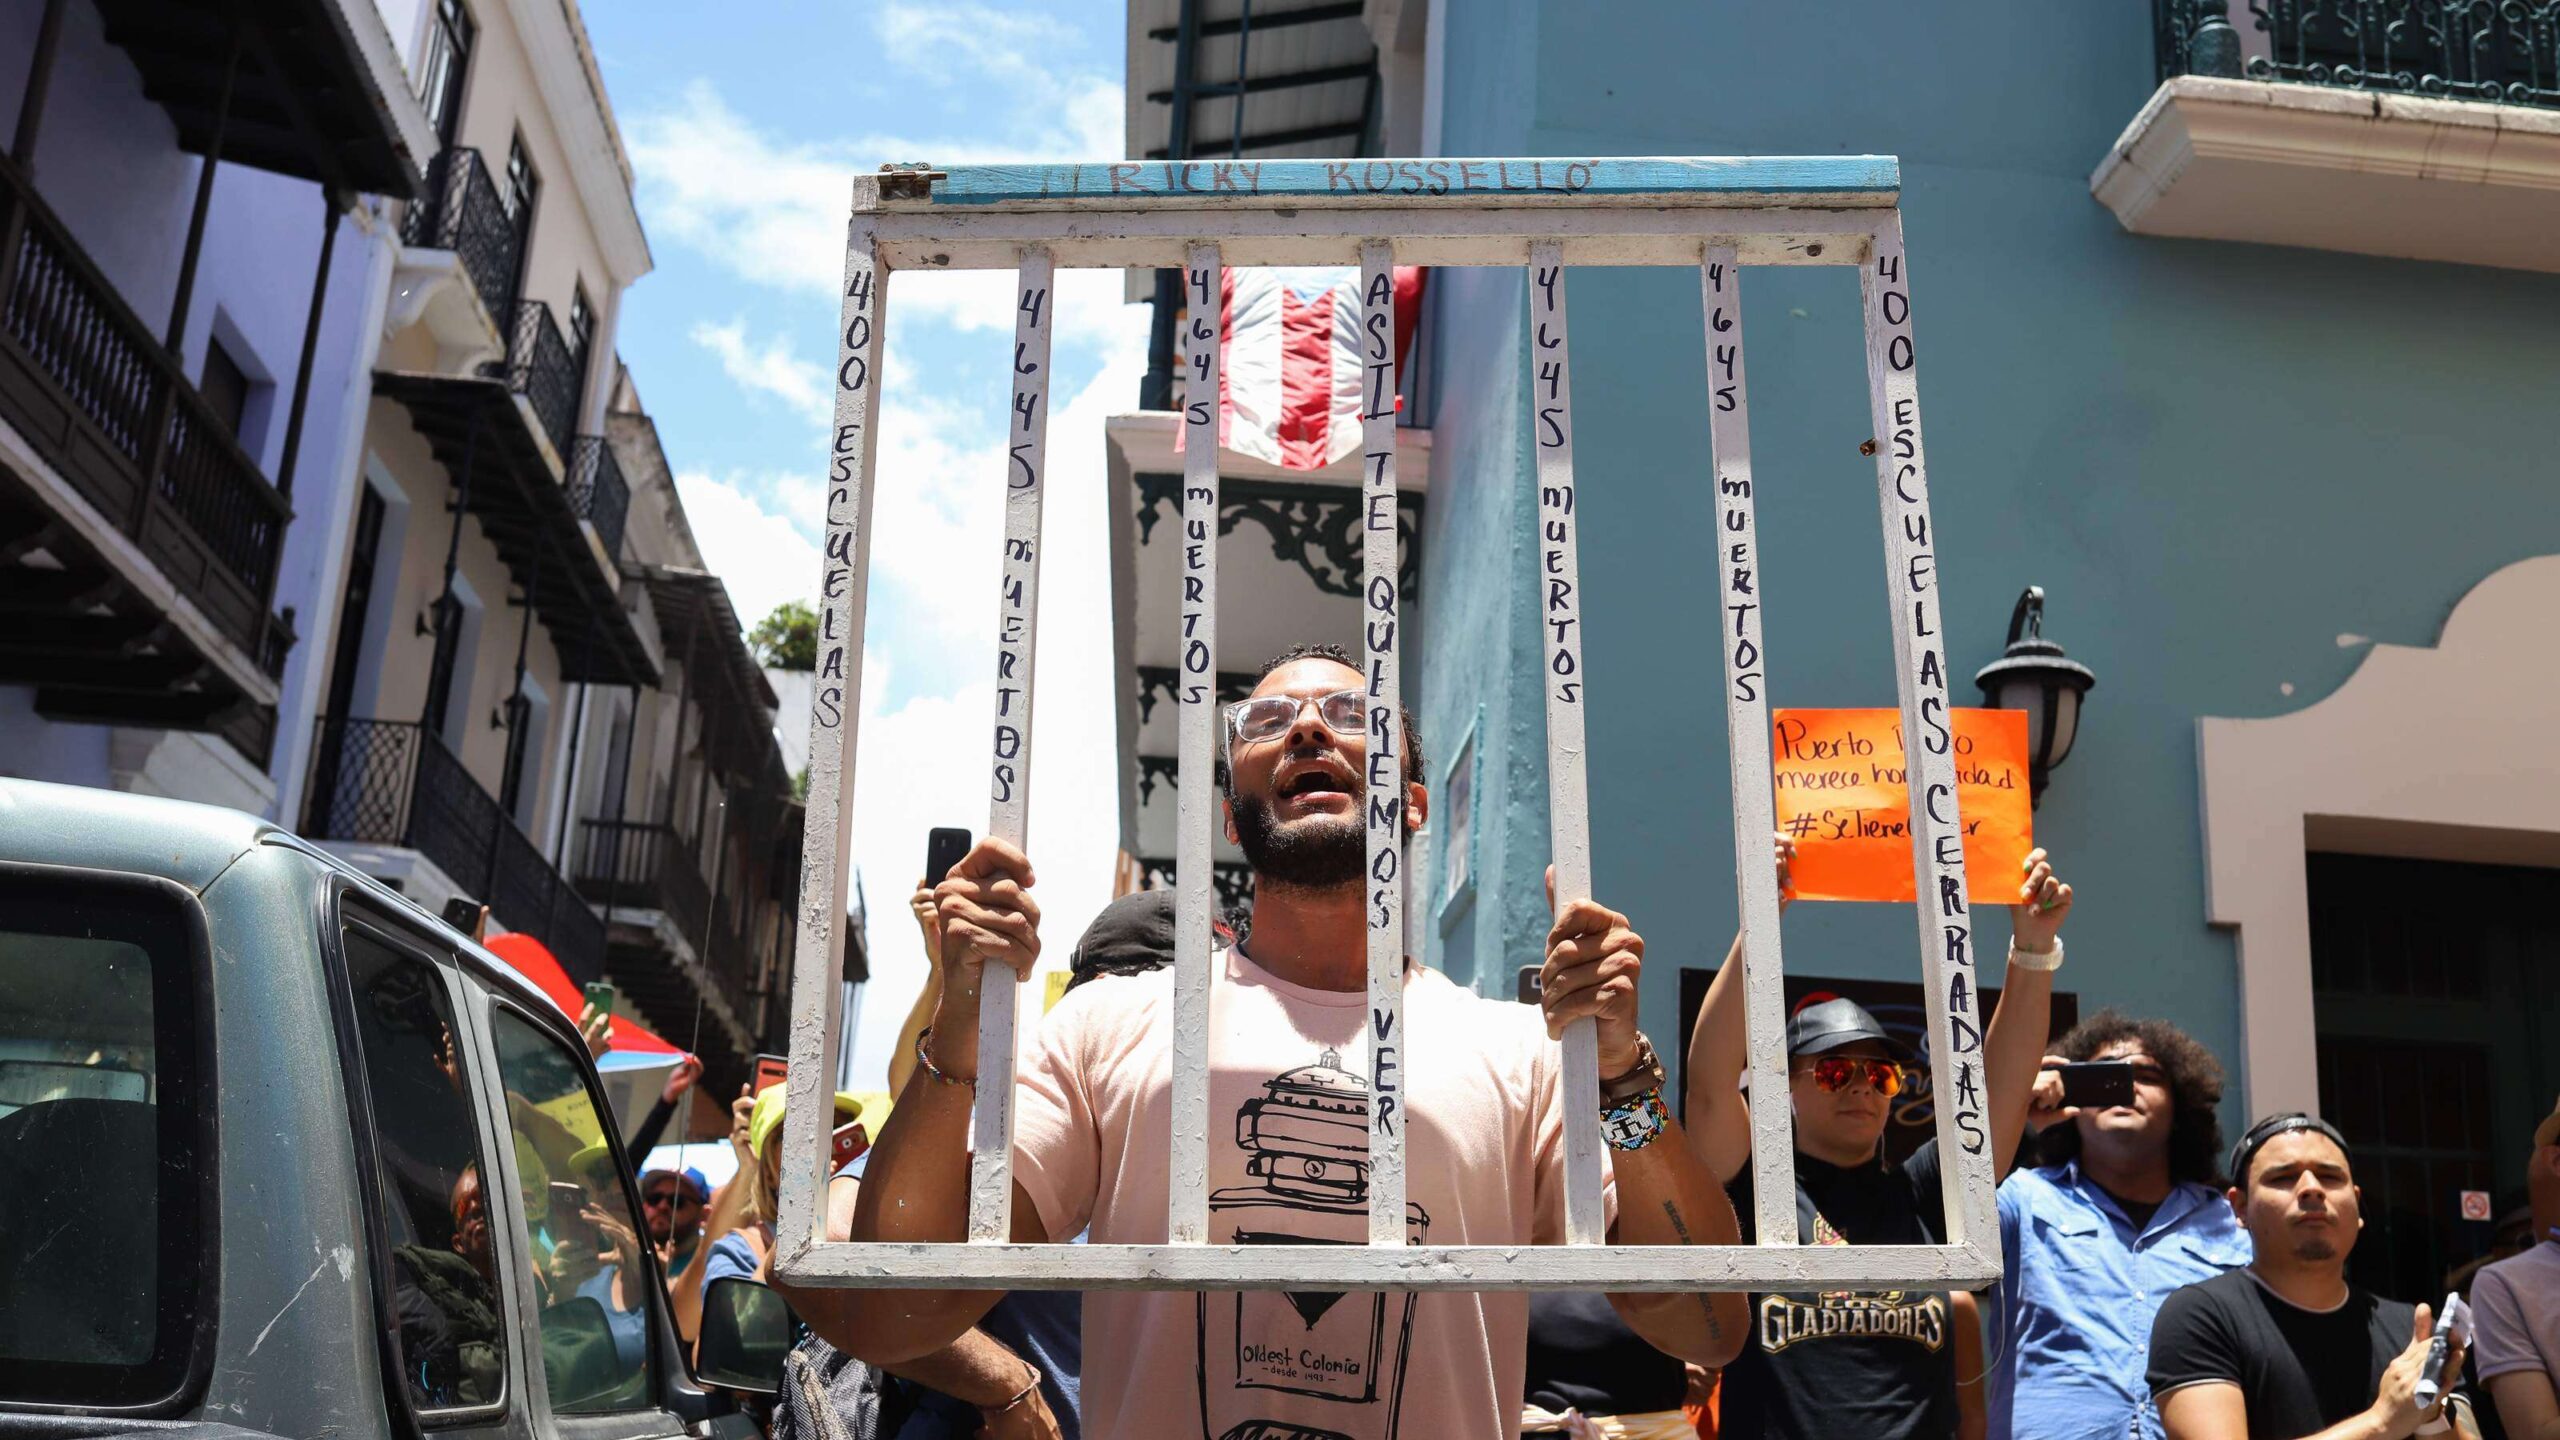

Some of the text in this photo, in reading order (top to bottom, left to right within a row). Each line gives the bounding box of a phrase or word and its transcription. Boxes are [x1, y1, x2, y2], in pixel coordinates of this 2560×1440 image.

[1108, 162, 1261, 197] RICKY
[1186, 268, 1214, 426] 4645
[1364, 272, 1394, 421] ASI
[1537, 265, 1565, 448] 4645
[1709, 263, 1736, 412] 4645
[1879, 256, 1914, 372] 400
[1008, 288, 1046, 489] 4645
[814, 271, 871, 729] 400 ESCUELAS
[1365, 452, 1397, 532] TE
[1893, 399, 1950, 755] ESCUELAS
[1776, 718, 1874, 761] Puerto
[1777, 768, 1865, 789] merece
[1926, 783, 1986, 1155] CERRADAS
[1373, 1008, 1396, 1137] VER
[1243, 1344, 1293, 1366] Oldest
[1304, 1373, 1324, 1382] 1493
[1760, 1295, 1945, 1351] GLADIADORES
